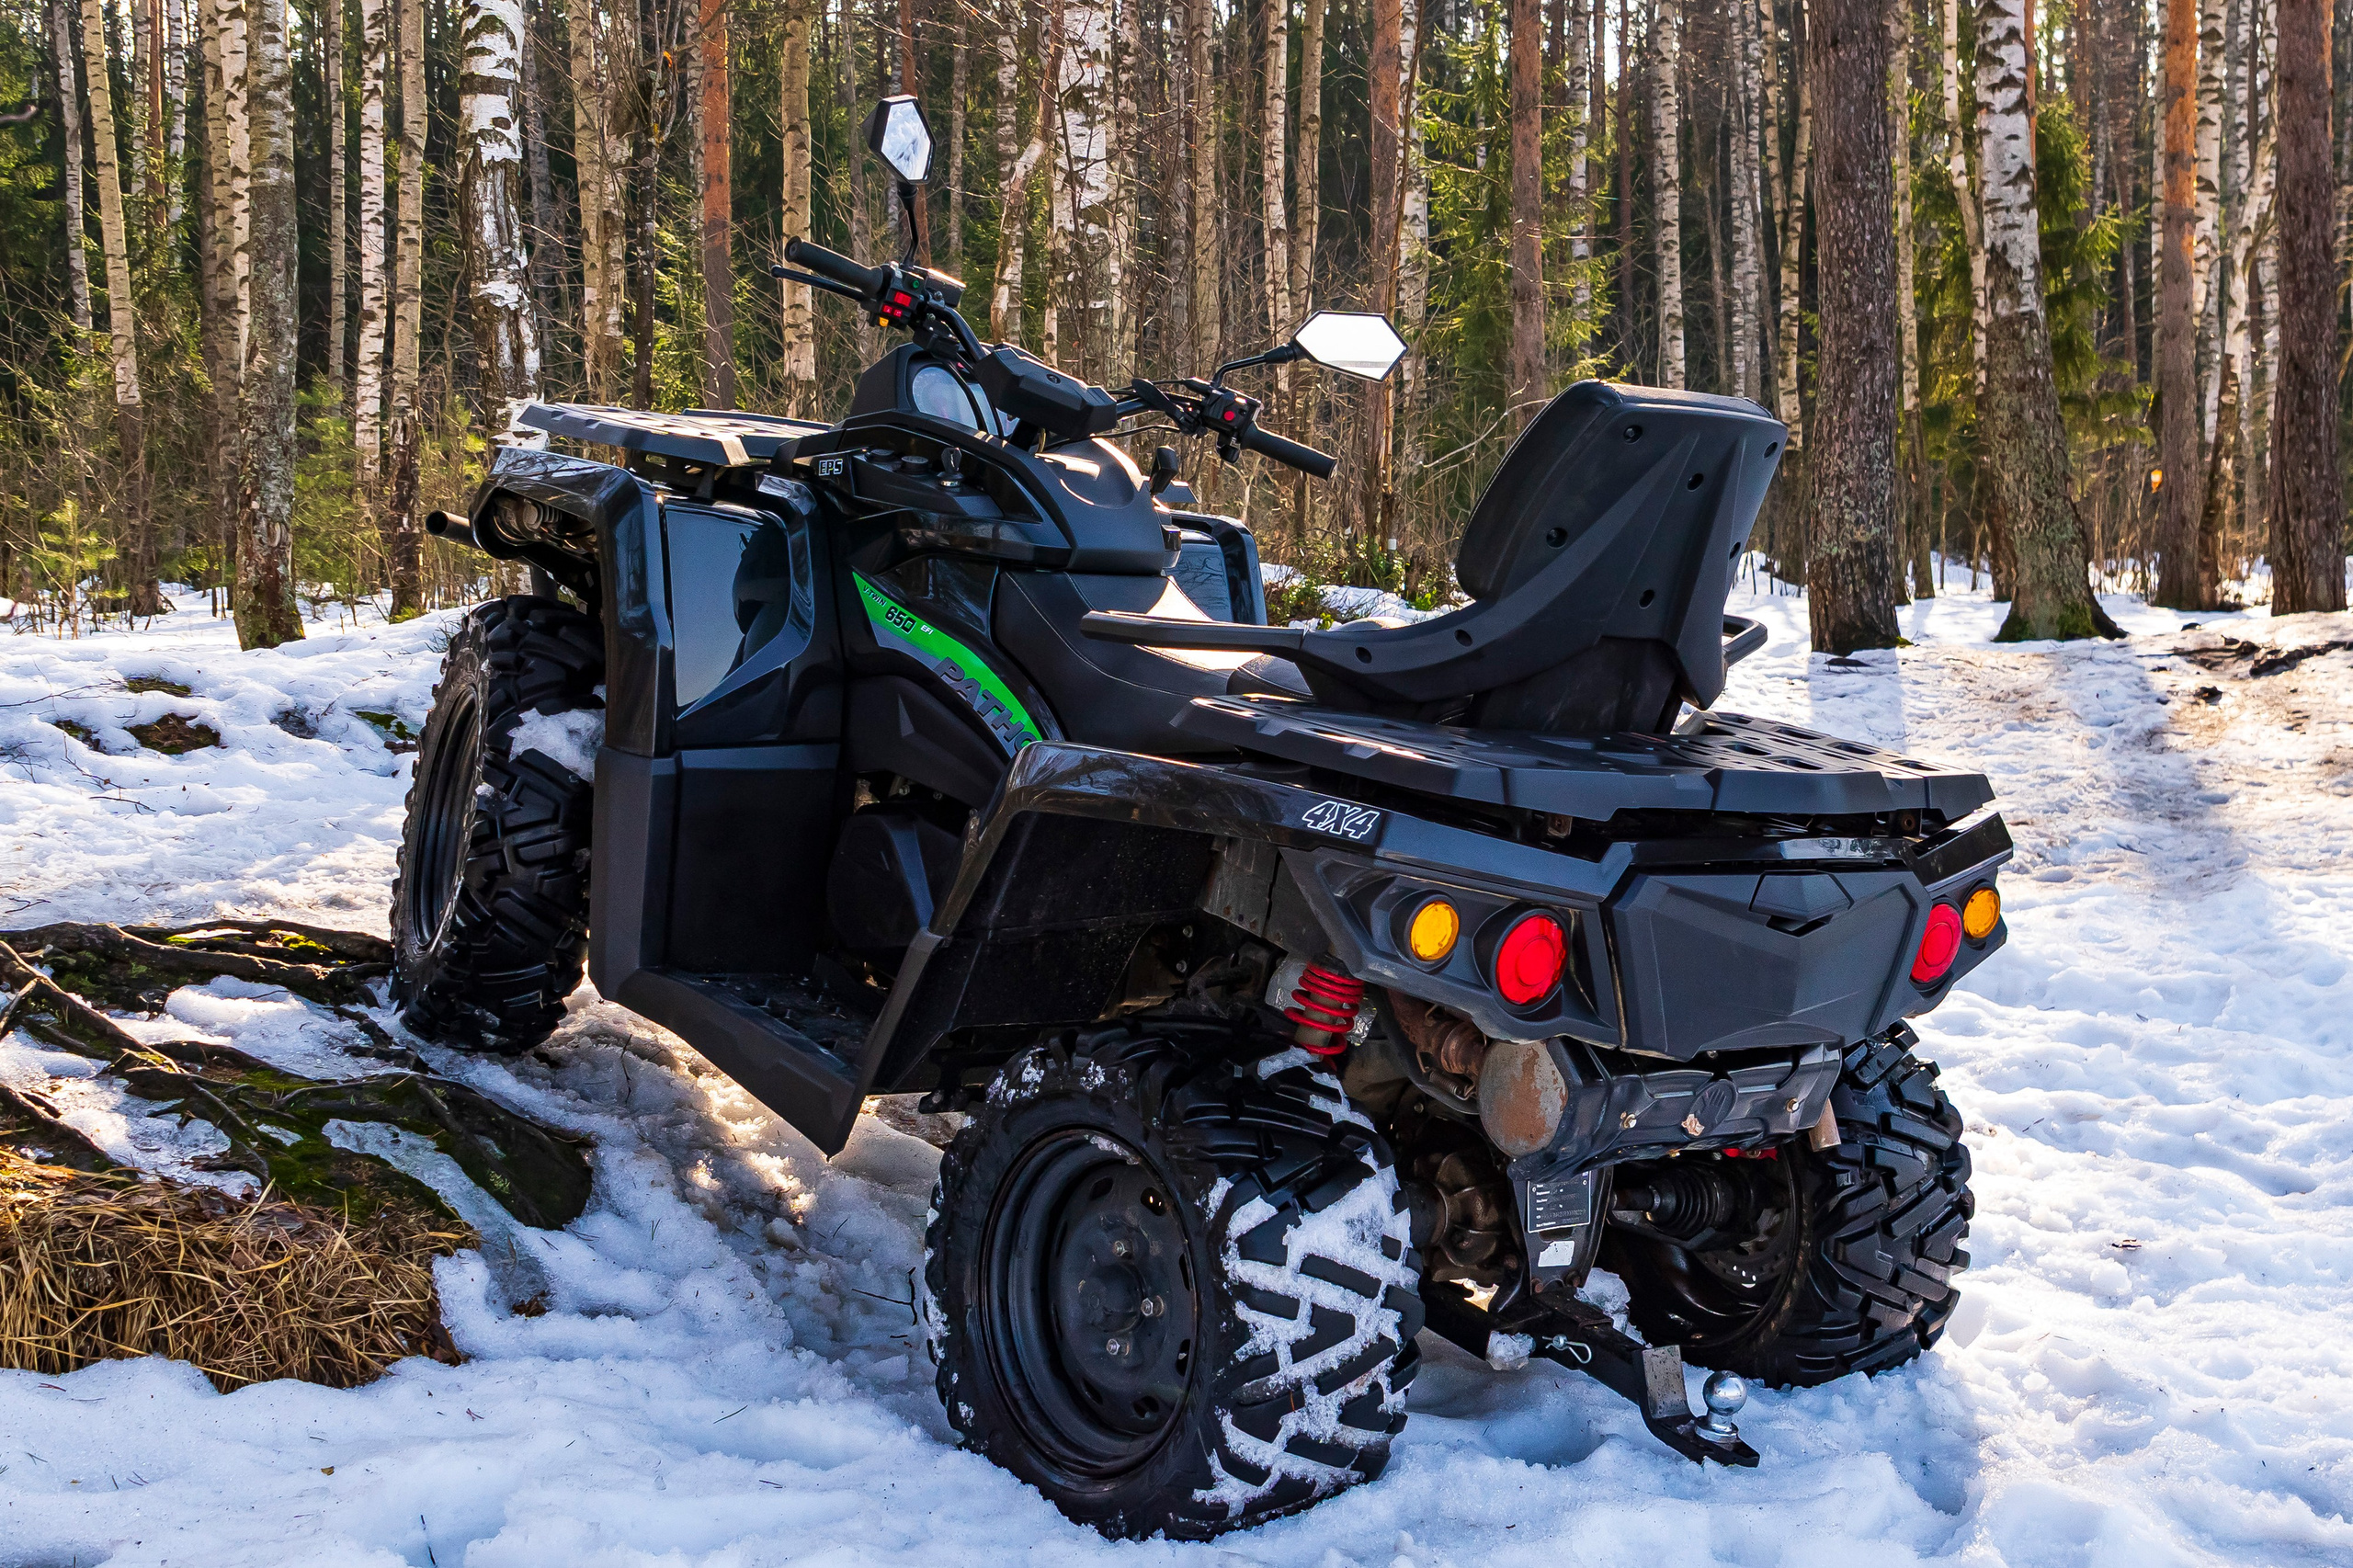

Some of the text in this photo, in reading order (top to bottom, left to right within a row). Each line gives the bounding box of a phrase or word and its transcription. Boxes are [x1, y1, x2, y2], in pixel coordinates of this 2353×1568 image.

[819, 459, 843, 476] EPS
[863, 585, 934, 635] V-TWIN 650 EFI
[1302, 800, 1381, 839] 4X4
